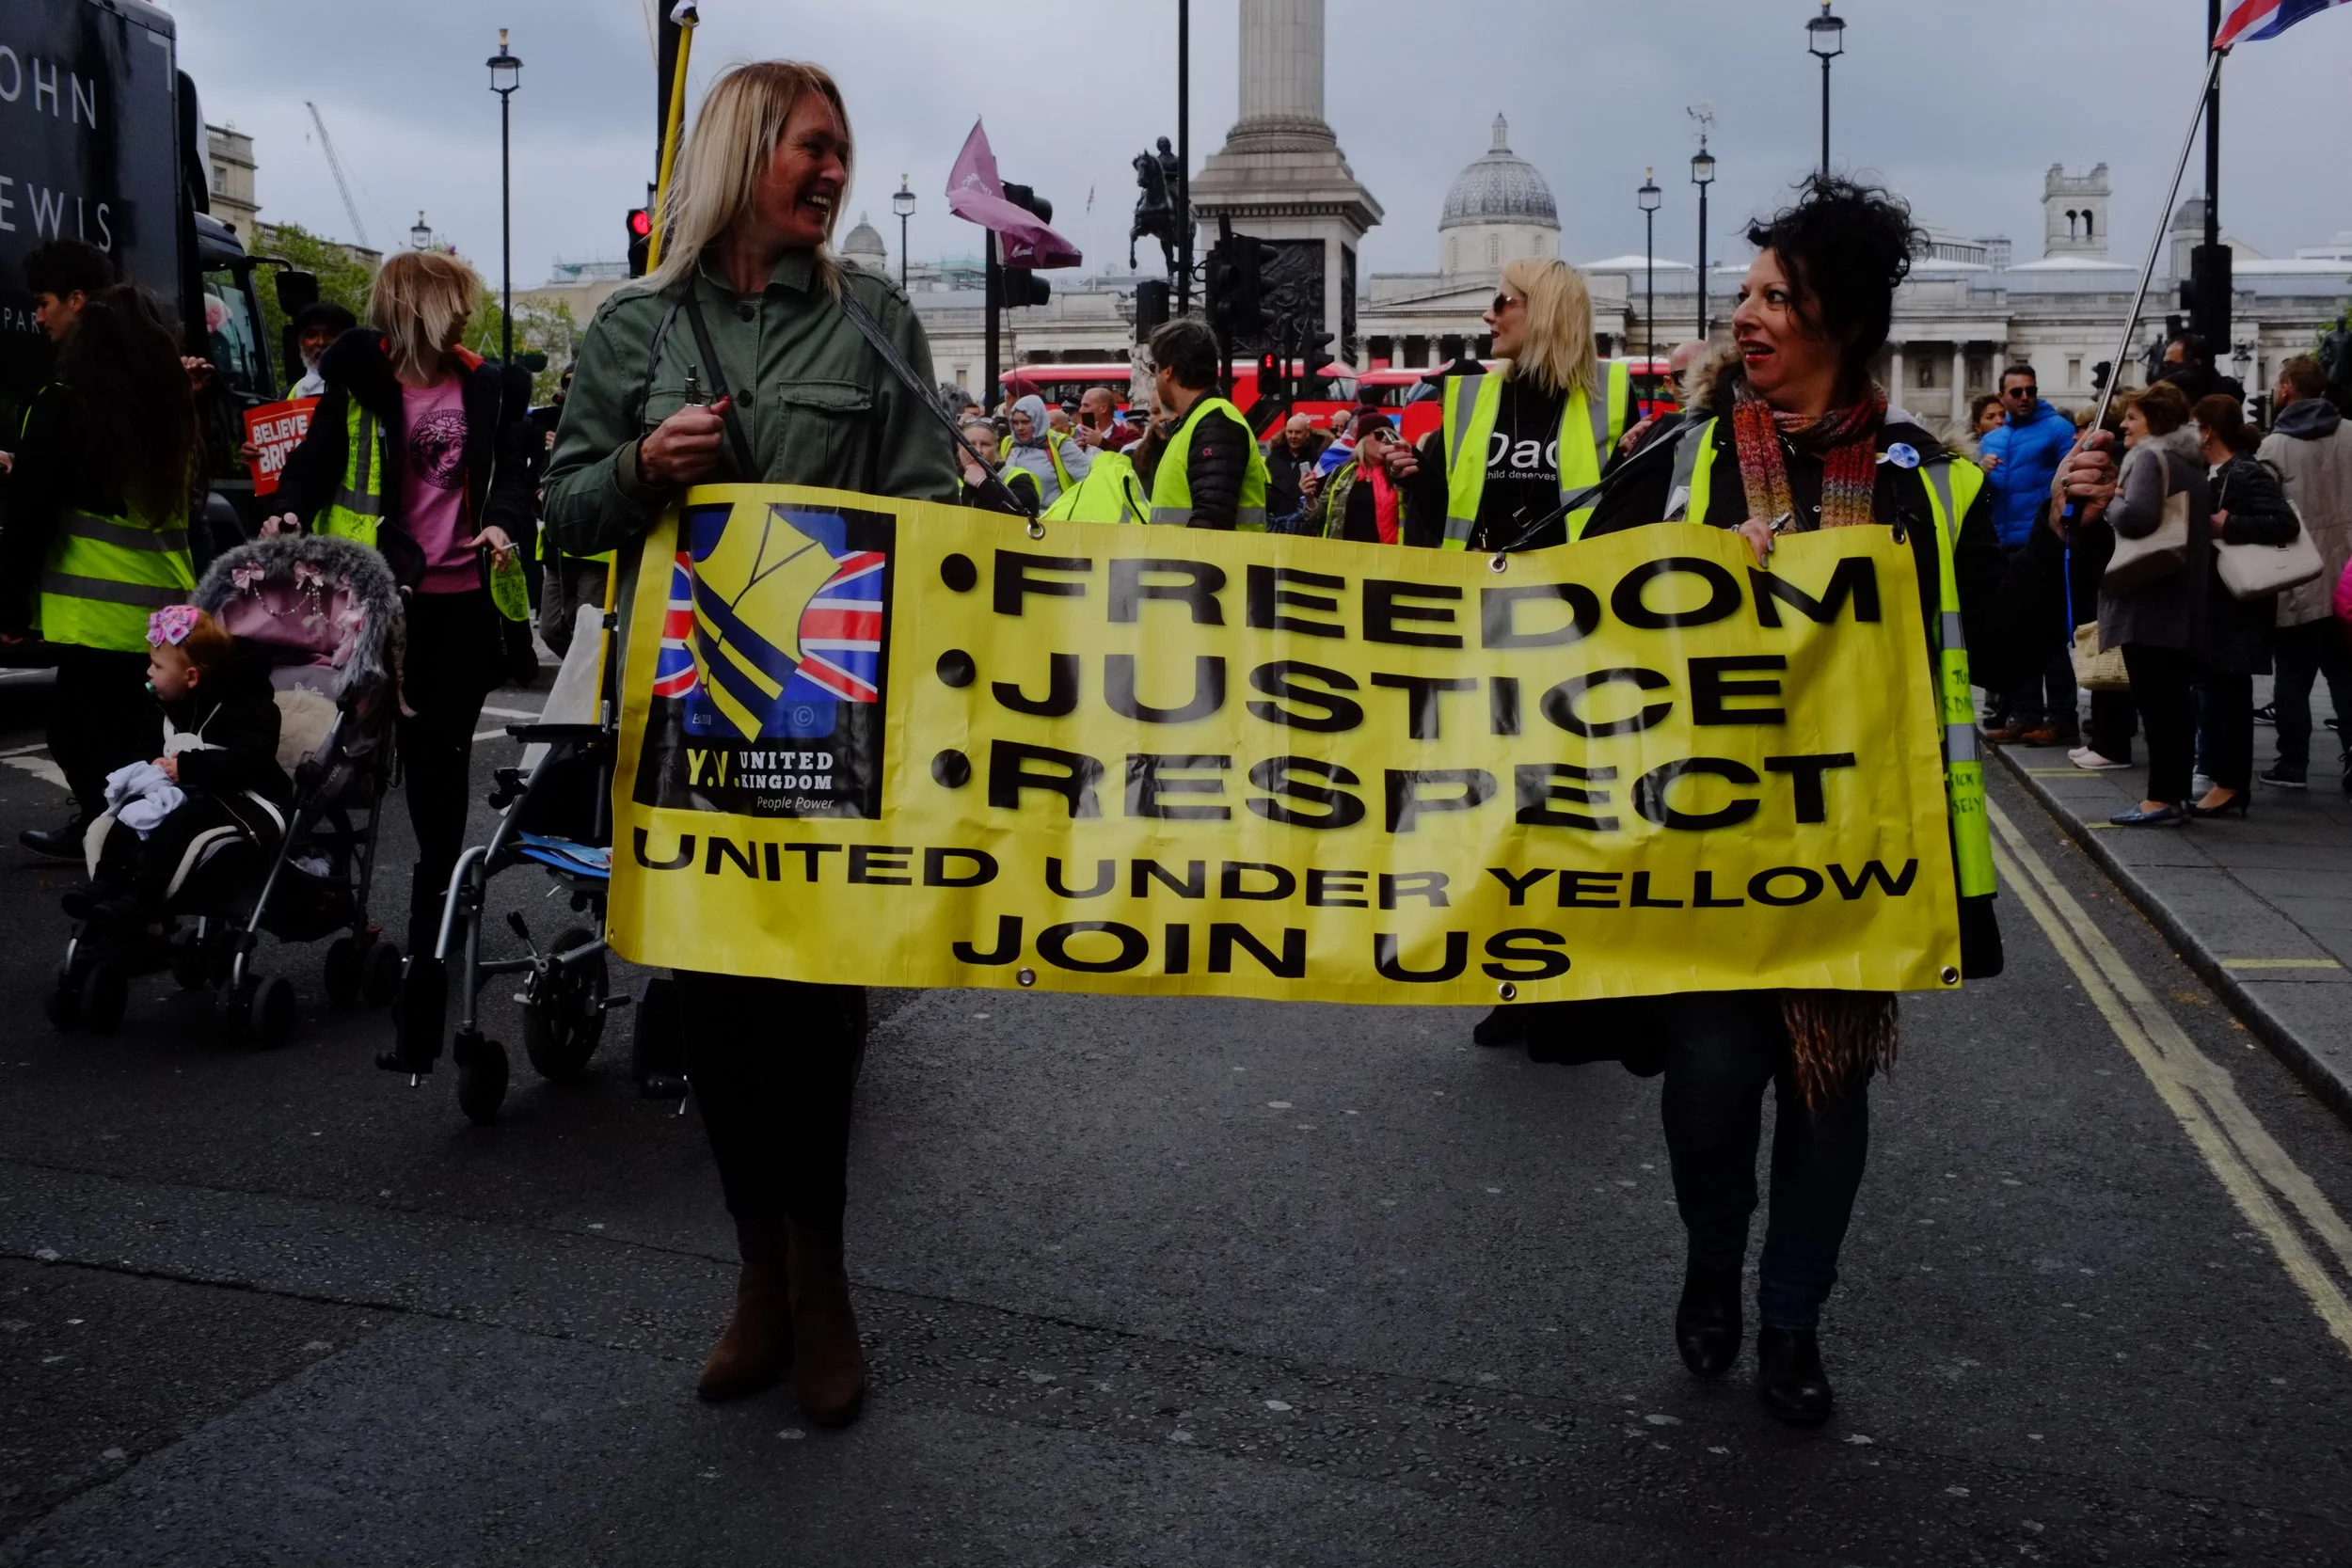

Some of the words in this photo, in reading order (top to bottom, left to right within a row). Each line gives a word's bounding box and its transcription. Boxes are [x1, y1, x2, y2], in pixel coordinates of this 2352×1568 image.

[0, 44, 97, 130] OHN
[0, 175, 113, 254] EWIS
[3, 306, 51, 336] PAR
[252, 414, 309, 446] BELIEVE
[1508, 470, 1556, 482] deserves
[993, 549, 1882, 651] FREEDOM
[992, 653, 1788, 742] JUSTICE
[739, 752, 834, 770] UNITED
[739, 774, 833, 790] KINGDOM
[989, 739, 1856, 834] RESPECT
[756, 796, 792, 813] People
[795, 797, 835, 810] Power
[634, 827, 998, 887] UNITED
[1046, 857, 1449, 910] UNDER
[1487, 859, 1917, 908] YELLOW
[953, 915, 1306, 978] JOIN
[1375, 928, 1570, 982] US
